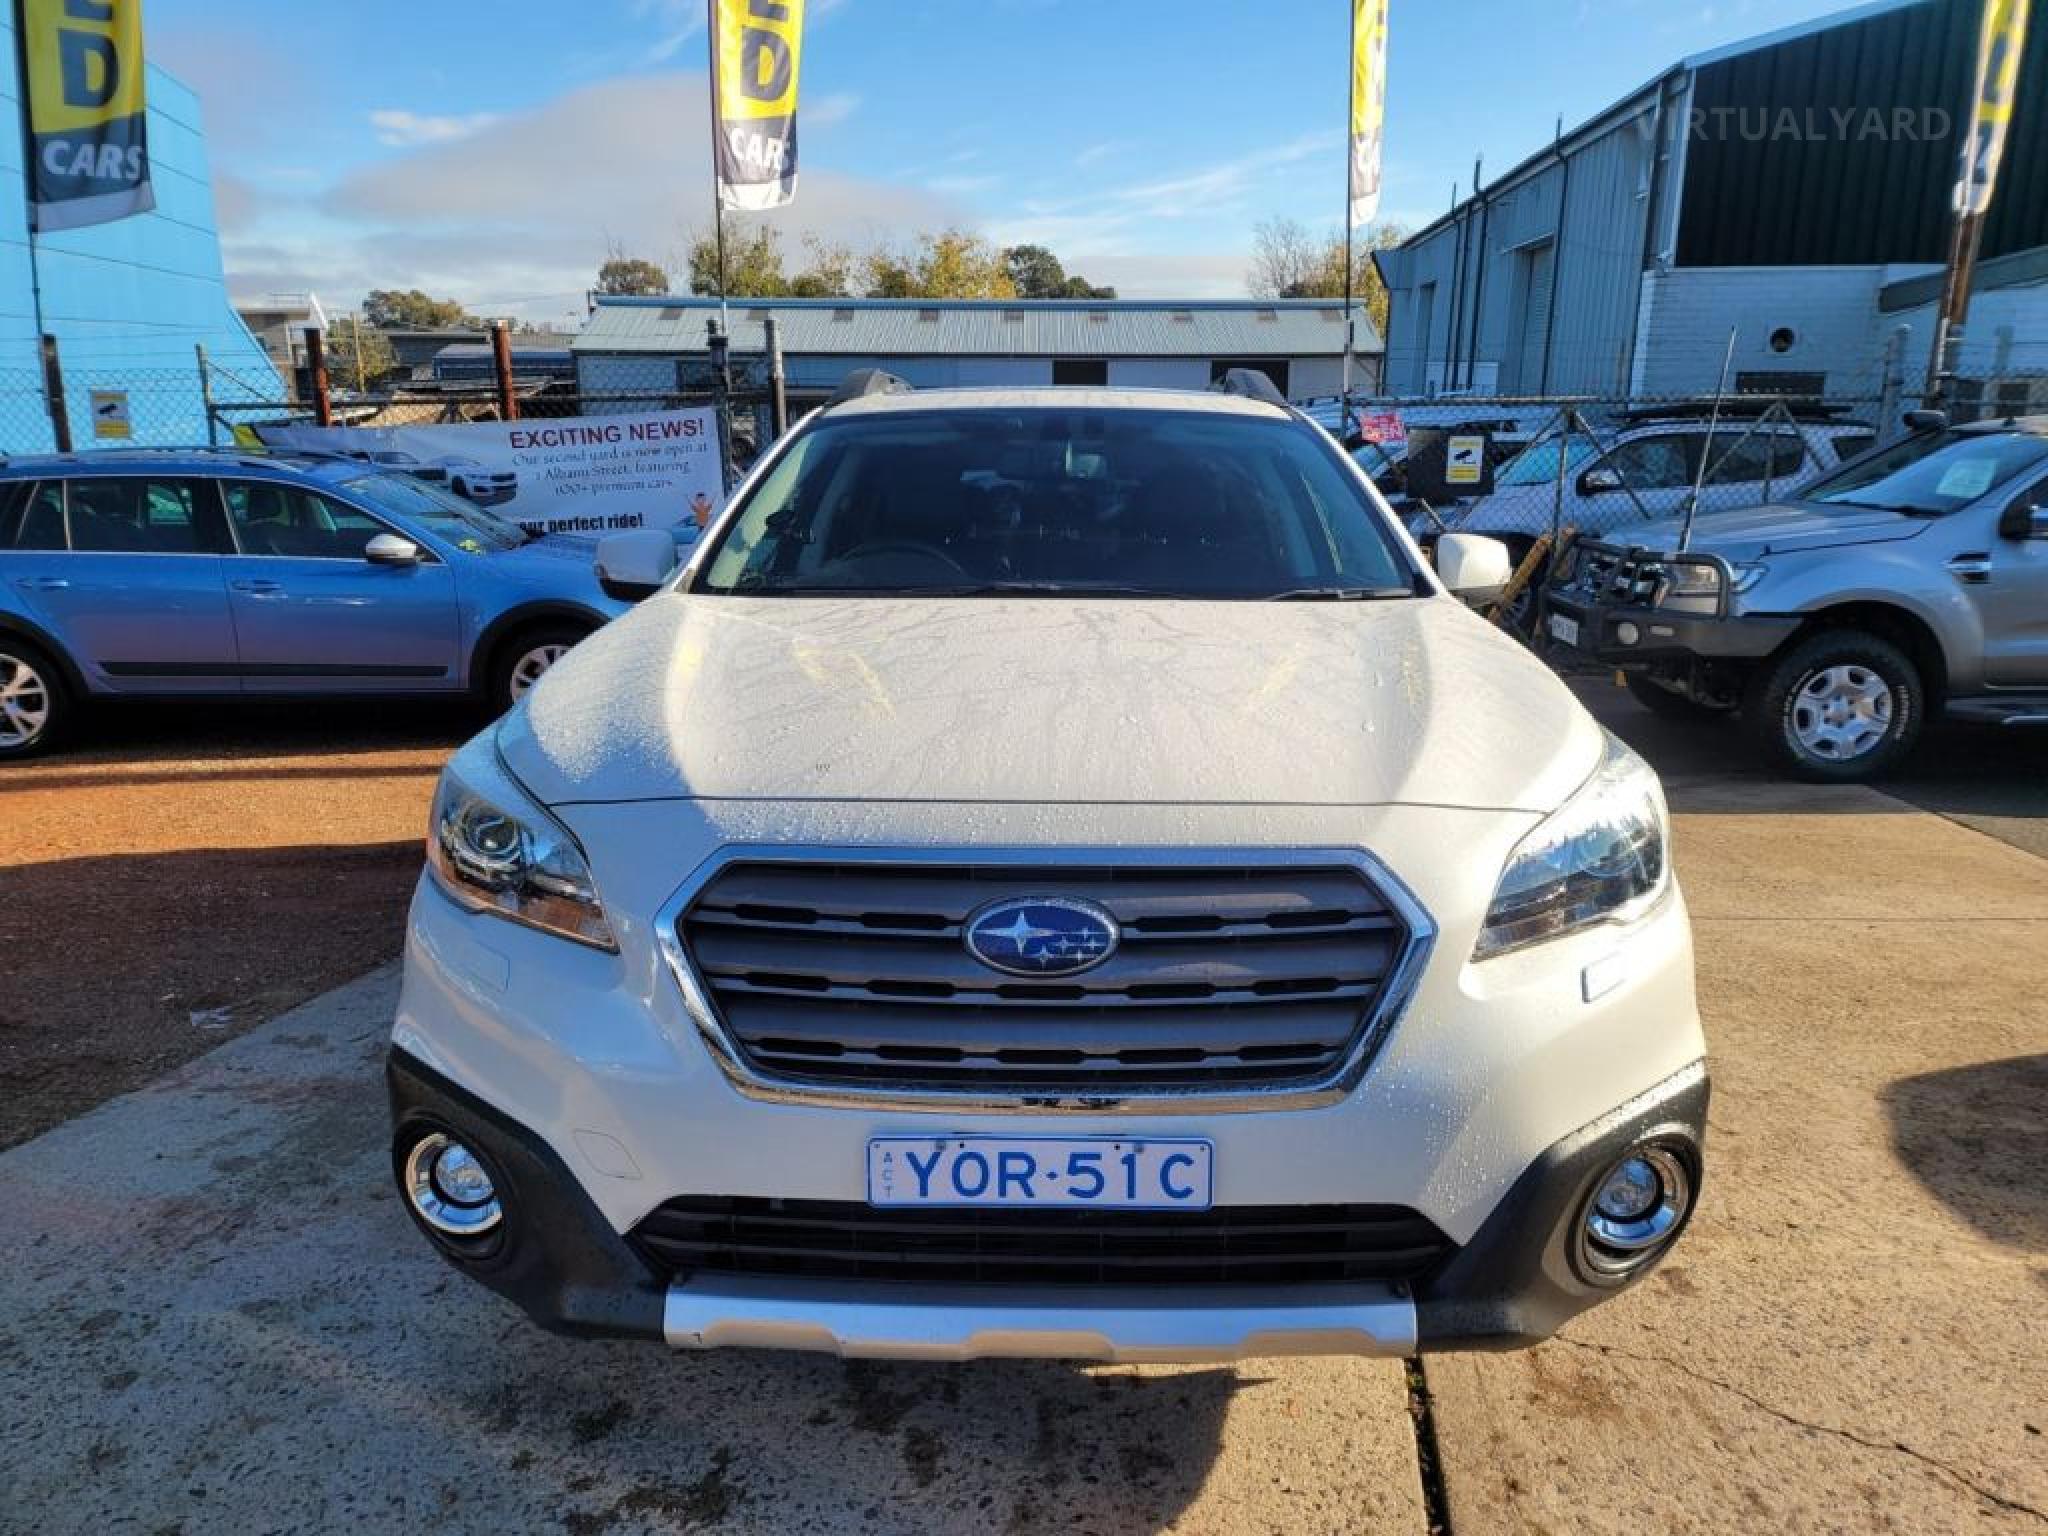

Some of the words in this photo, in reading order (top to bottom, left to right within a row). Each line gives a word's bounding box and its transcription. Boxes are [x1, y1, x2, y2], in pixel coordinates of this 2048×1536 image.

[43, 139, 143, 179] CARS
[510, 424, 622, 449] EXCITING
[629, 417, 705, 441] NEWS!
[512, 453, 537, 466] Our
[543, 448, 585, 463] second
[590, 445, 619, 464] yard
[621, 450, 632, 459] is
[635, 447, 661, 457] now
[664, 443, 693, 458] open
[697, 441, 707, 453] at
[635, 461, 689, 475] featuring
[592, 480, 645, 496] premium
[647, 478, 673, 489] cars
[519, 520, 545, 535] our
[547, 515, 604, 533] perfect
[607, 512, 644, 529] ride!
[882, 1151, 893, 1197] ACT
